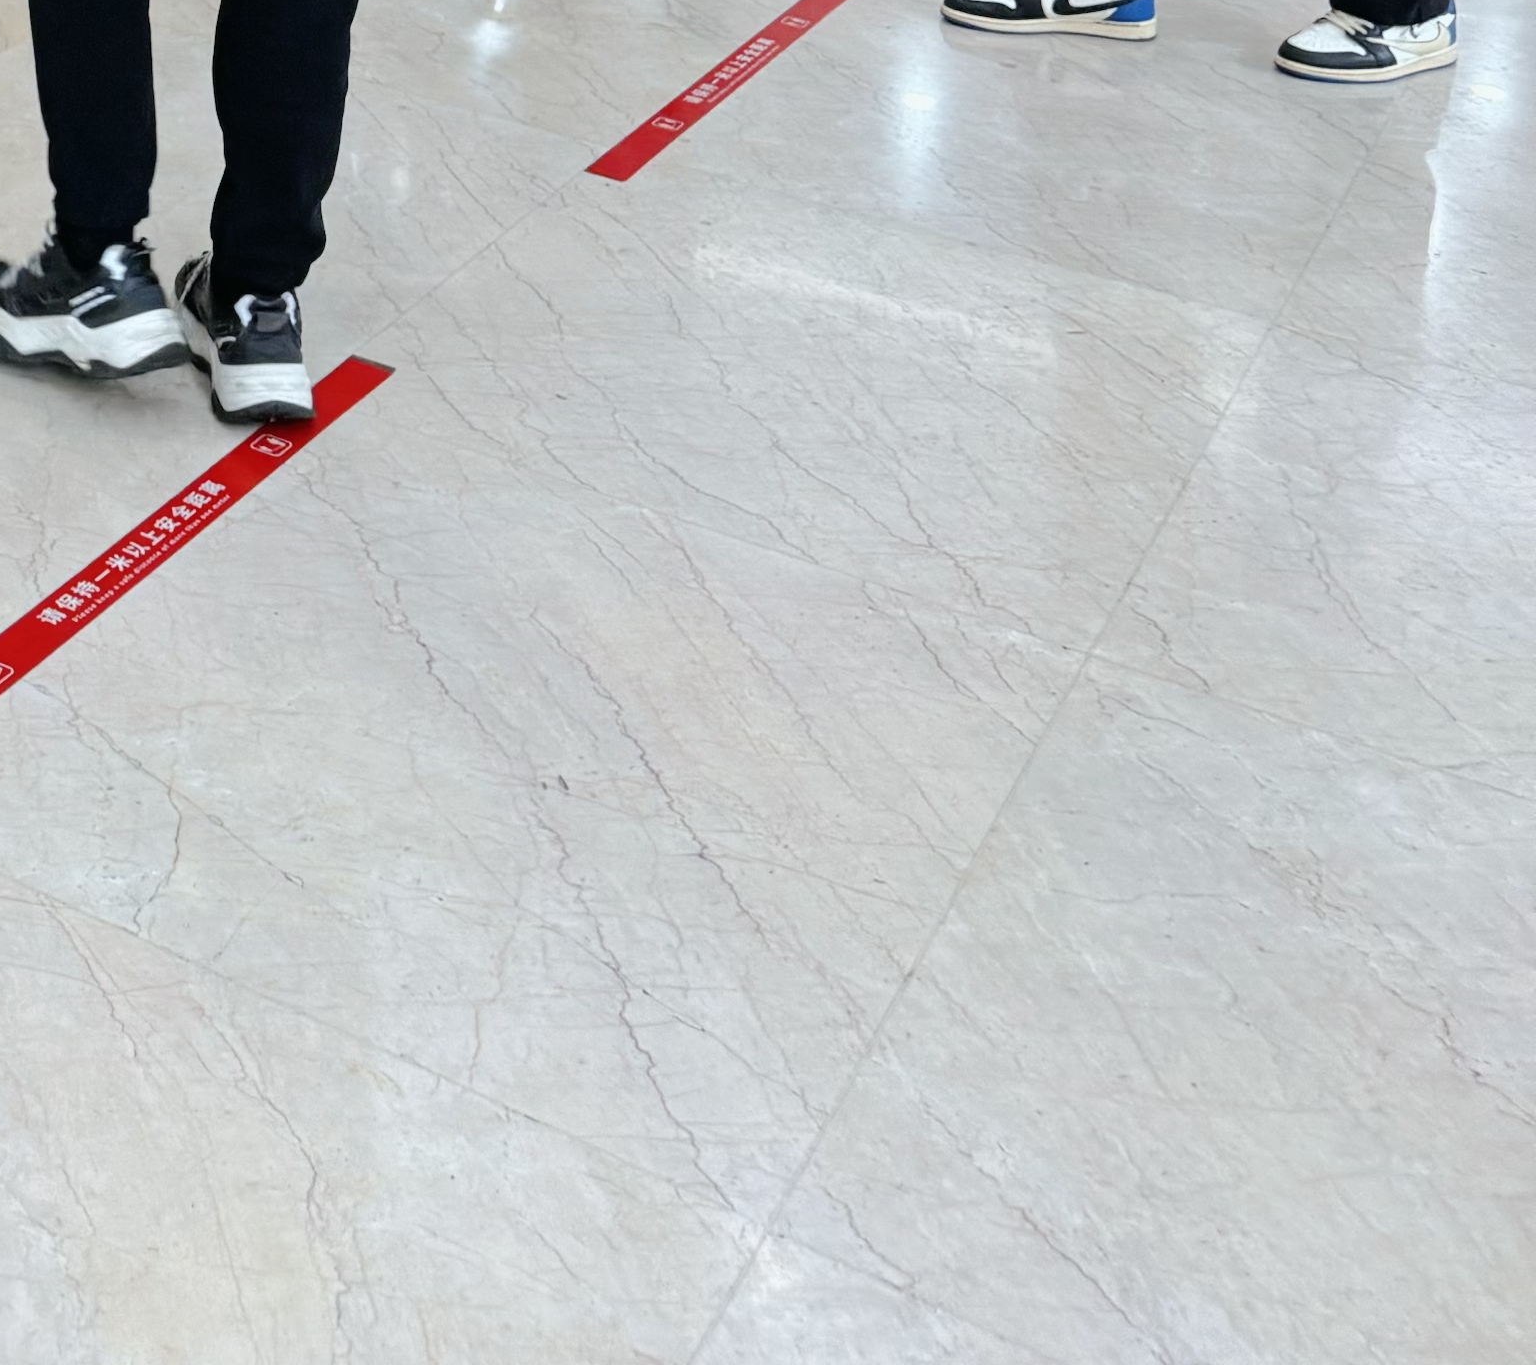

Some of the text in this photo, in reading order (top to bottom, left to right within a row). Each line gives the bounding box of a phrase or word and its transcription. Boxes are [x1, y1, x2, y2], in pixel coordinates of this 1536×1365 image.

[36, 479, 226, 625] 请保持一米以上安全距离
